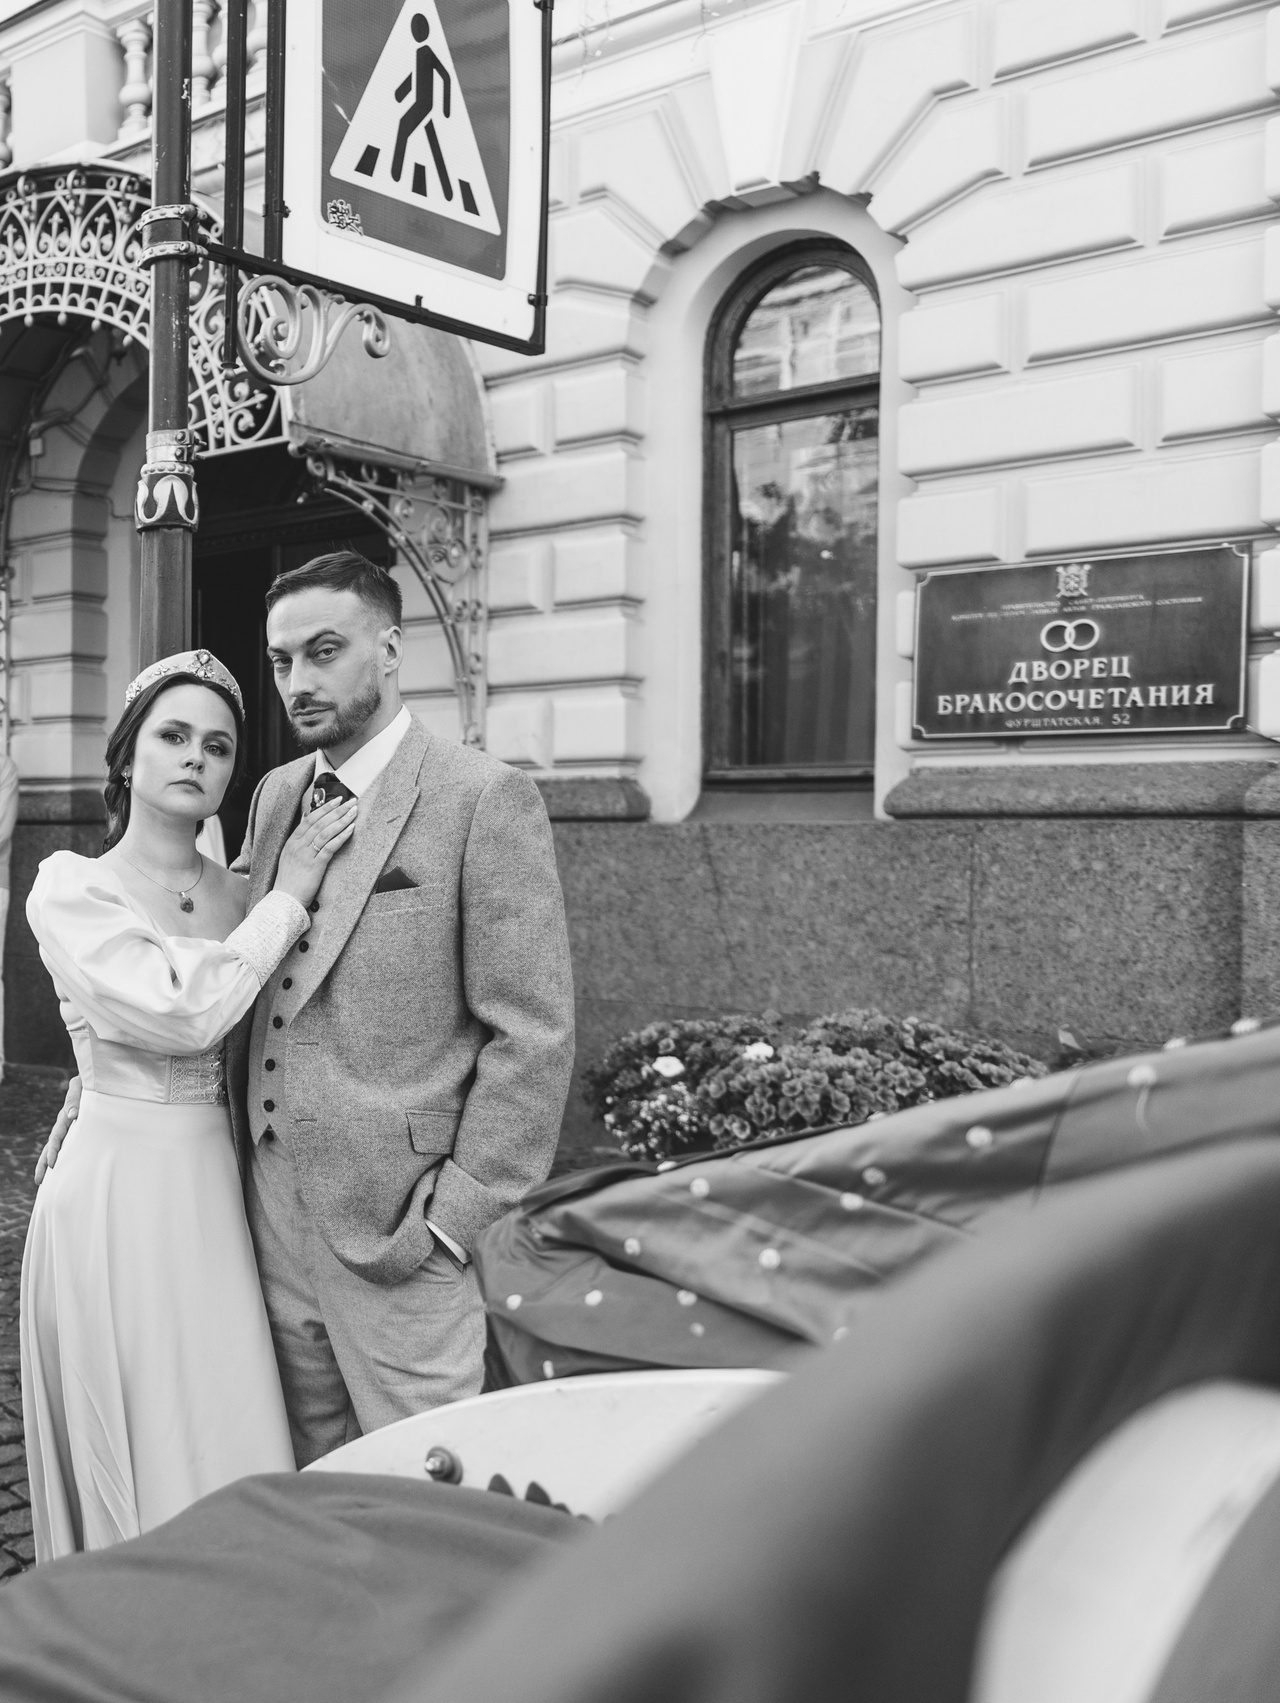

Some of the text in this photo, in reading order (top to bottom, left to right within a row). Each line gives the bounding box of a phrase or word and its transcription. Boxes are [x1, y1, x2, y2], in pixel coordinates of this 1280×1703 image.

[1008, 657, 1131, 685] ДВОРЕЦ
[937, 684, 1214, 716] БРАКОСОЧЕТАНИЯ
[1111, 713, 1130, 726] 52
